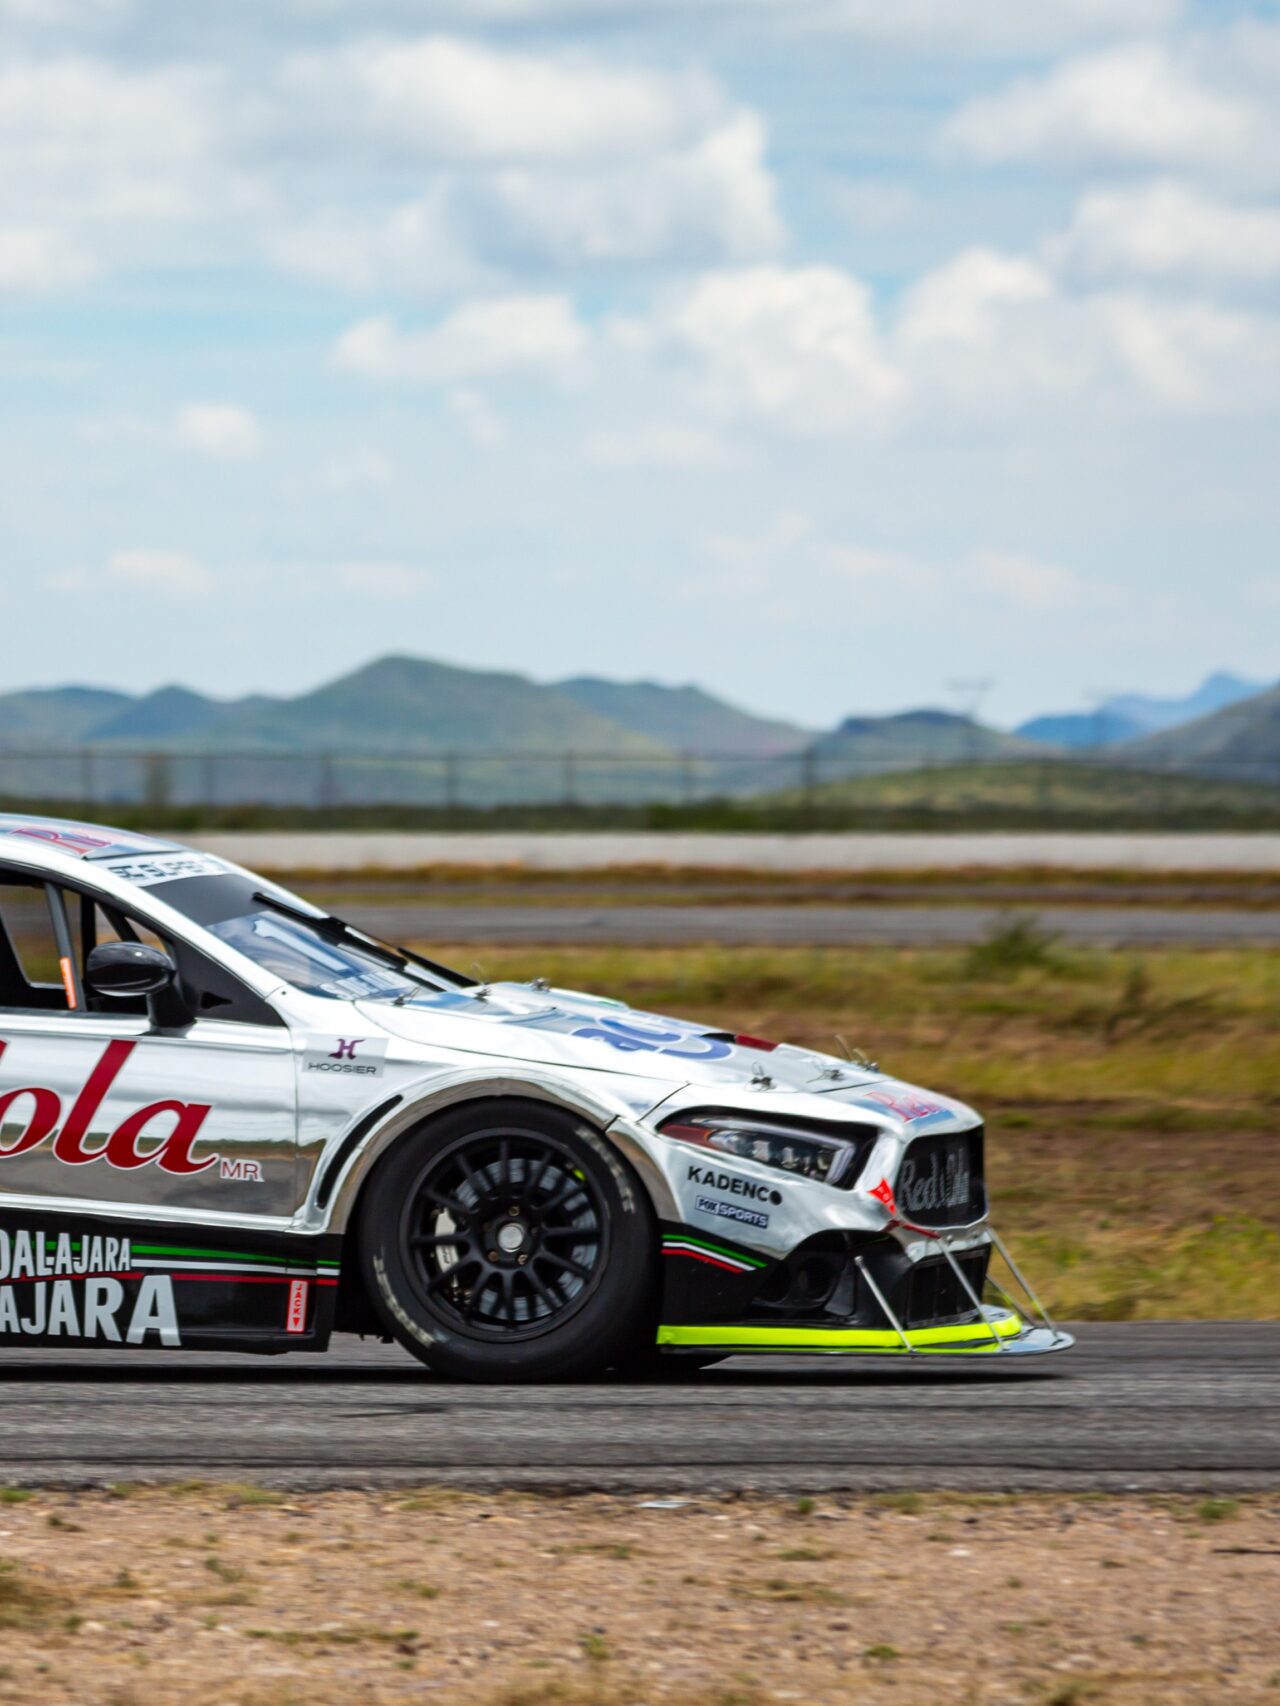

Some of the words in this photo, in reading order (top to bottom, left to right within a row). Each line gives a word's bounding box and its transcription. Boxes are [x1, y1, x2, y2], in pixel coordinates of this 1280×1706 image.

[308, 1063, 377, 1075] HOOSIER
[220, 1159, 263, 1183] MR
[719, 1204, 767, 1227] SPORTS
[293, 1284, 303, 1315] JACK
